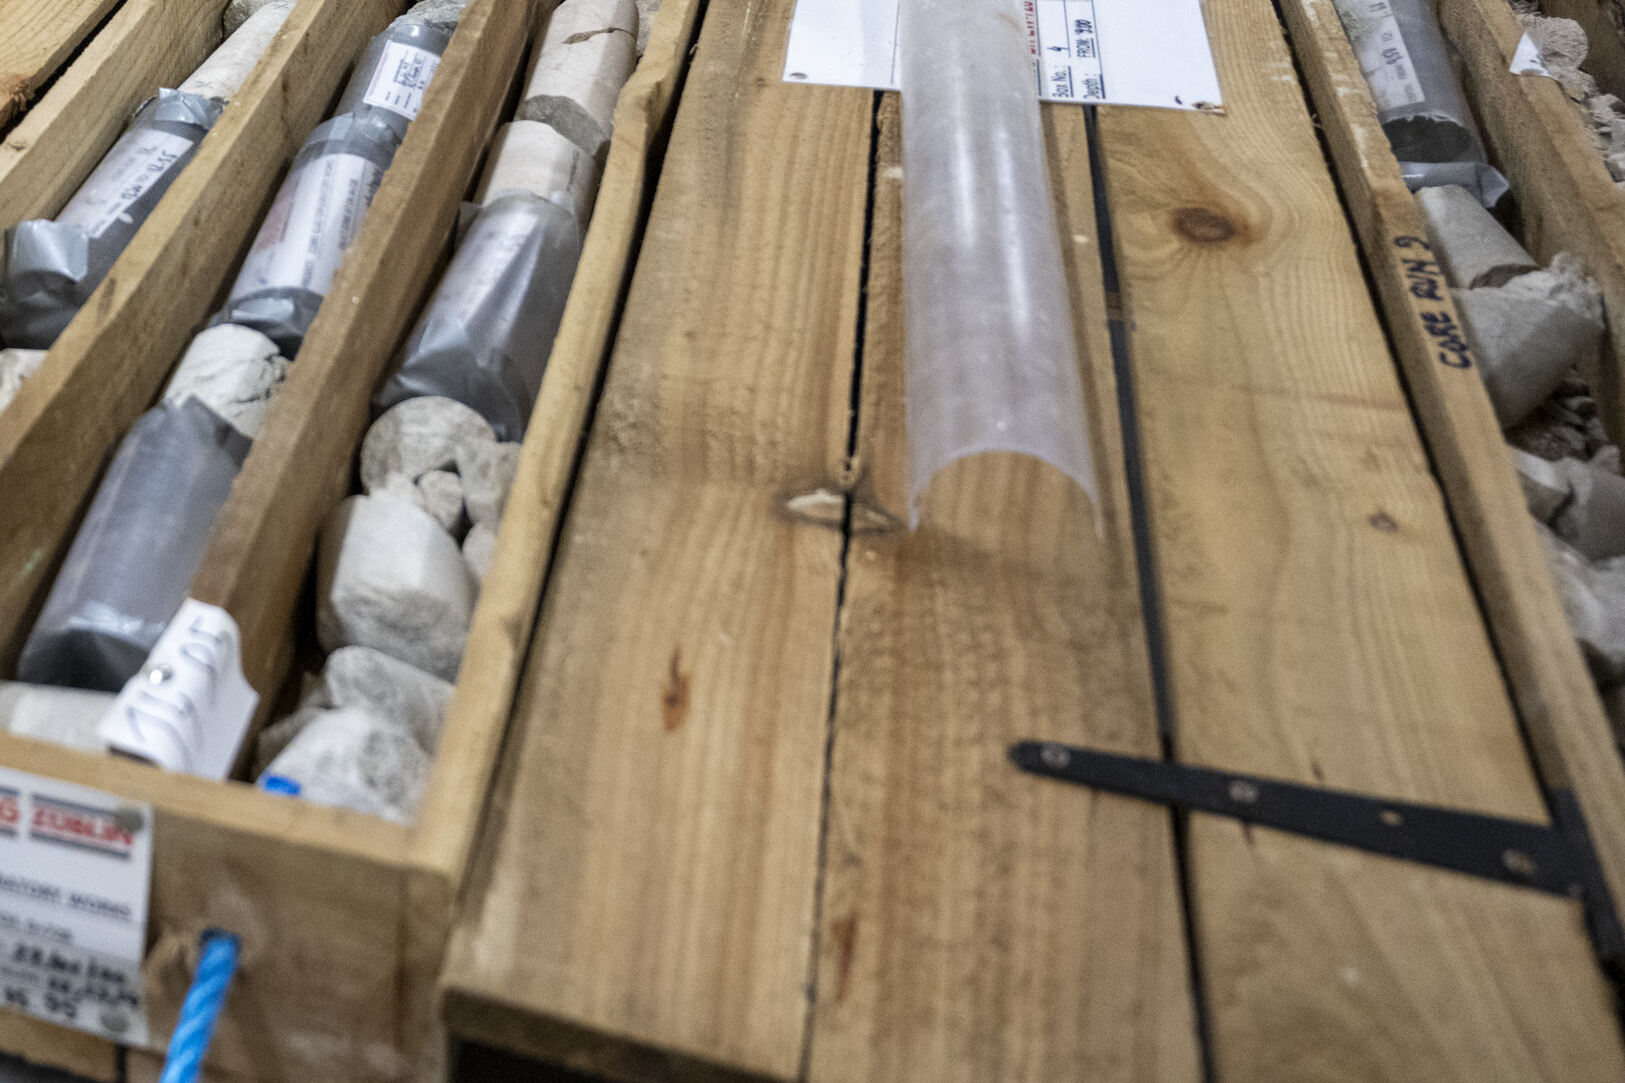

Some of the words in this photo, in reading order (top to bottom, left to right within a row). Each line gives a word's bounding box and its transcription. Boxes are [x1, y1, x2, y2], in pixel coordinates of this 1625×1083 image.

[1076, 37, 1091, 58] FROM:
[1401, 258, 1444, 302] RUN
[1419, 310, 1472, 370] CORE
